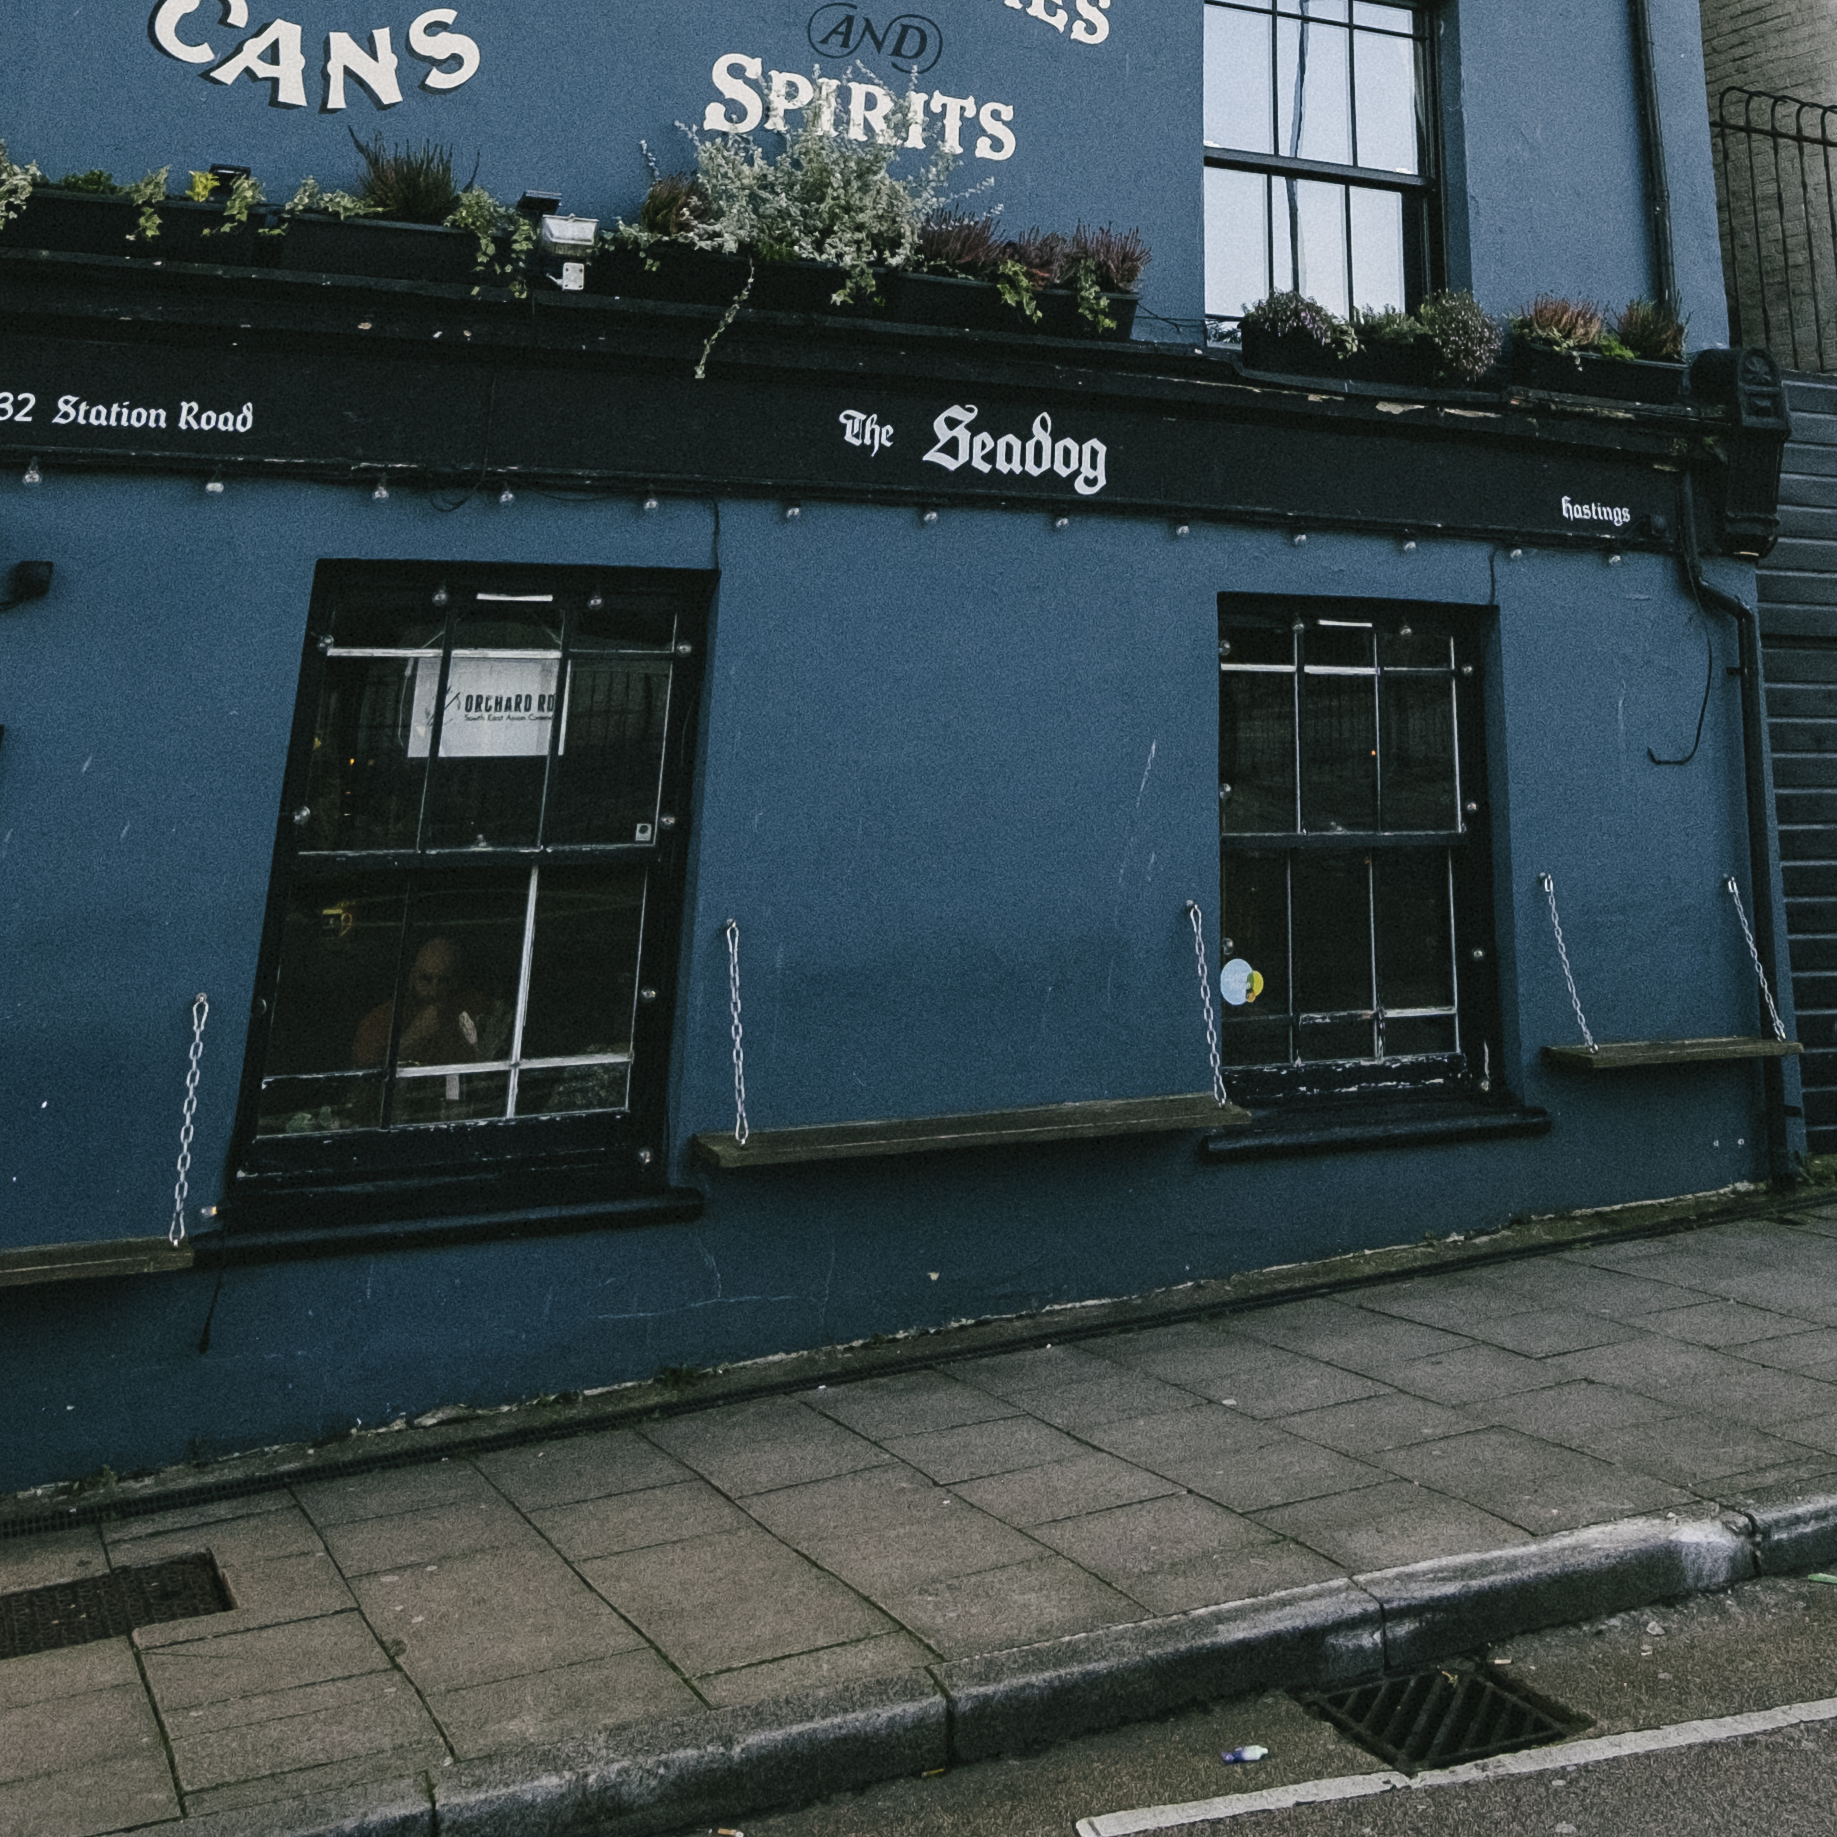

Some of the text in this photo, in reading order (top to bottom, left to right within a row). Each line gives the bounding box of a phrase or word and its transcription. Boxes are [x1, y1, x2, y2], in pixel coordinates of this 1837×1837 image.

[810, 6, 939, 71] AND
[703, 53, 1016, 161] SPIRITS
[52, 394, 167, 428] Station
[178, 401, 253, 433] Road
[839, 404, 1107, 495] The Seadog
[464, 693, 555, 713] ORCHARD RD
